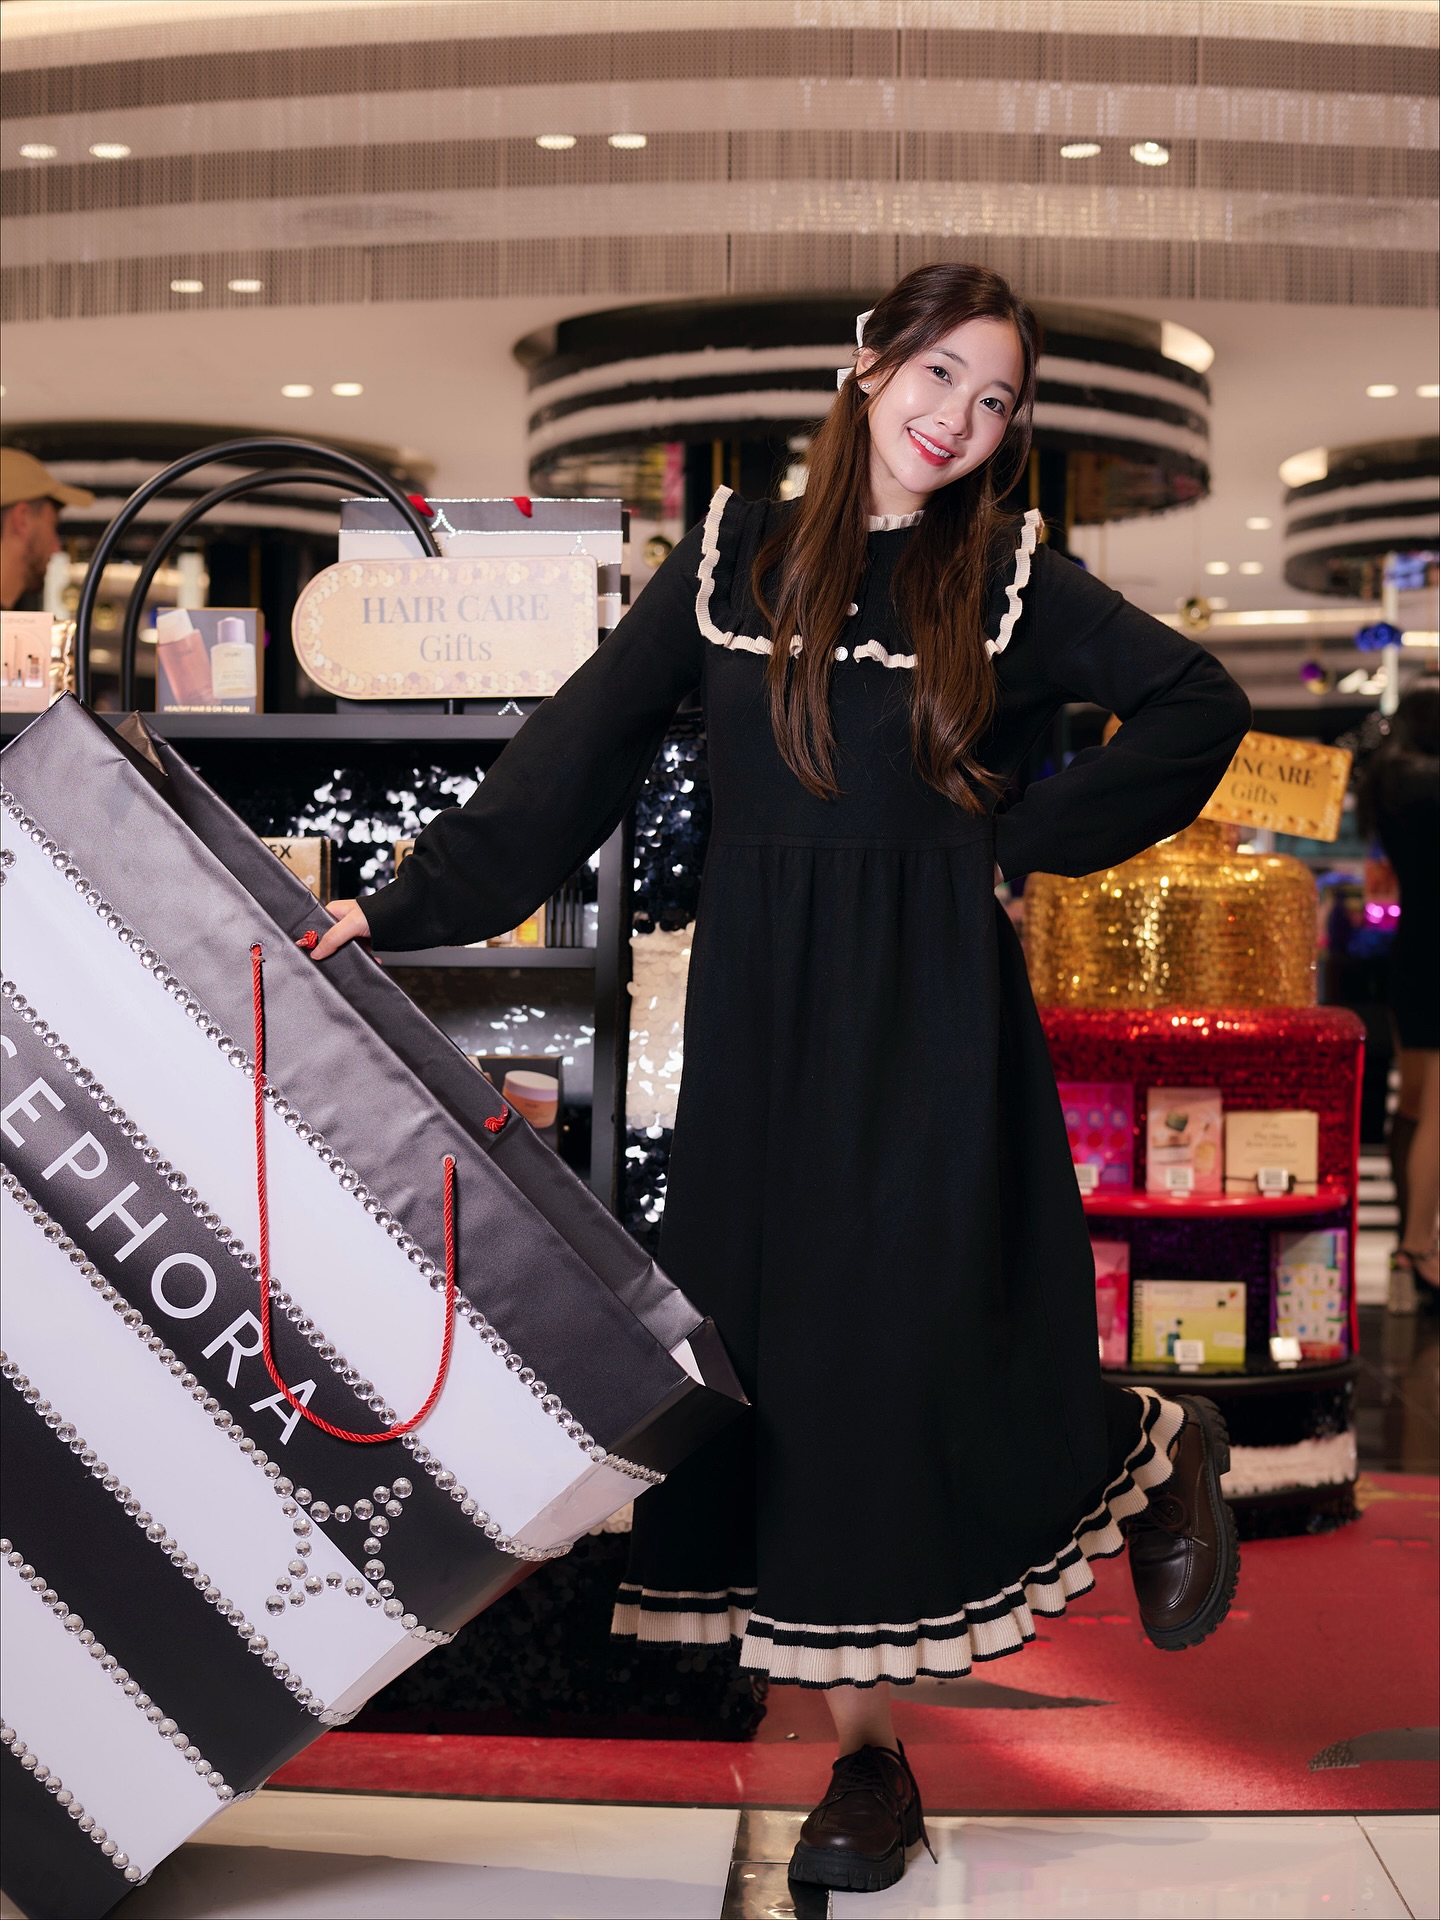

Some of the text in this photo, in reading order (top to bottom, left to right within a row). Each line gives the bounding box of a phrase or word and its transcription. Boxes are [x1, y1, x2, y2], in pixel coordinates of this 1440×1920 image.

[362, 594, 550, 624] HAIR CARE
[419, 634, 492, 663] Gifts
[1231, 755, 1318, 788] INCARE
[1230, 781, 1278, 806] Gifts
